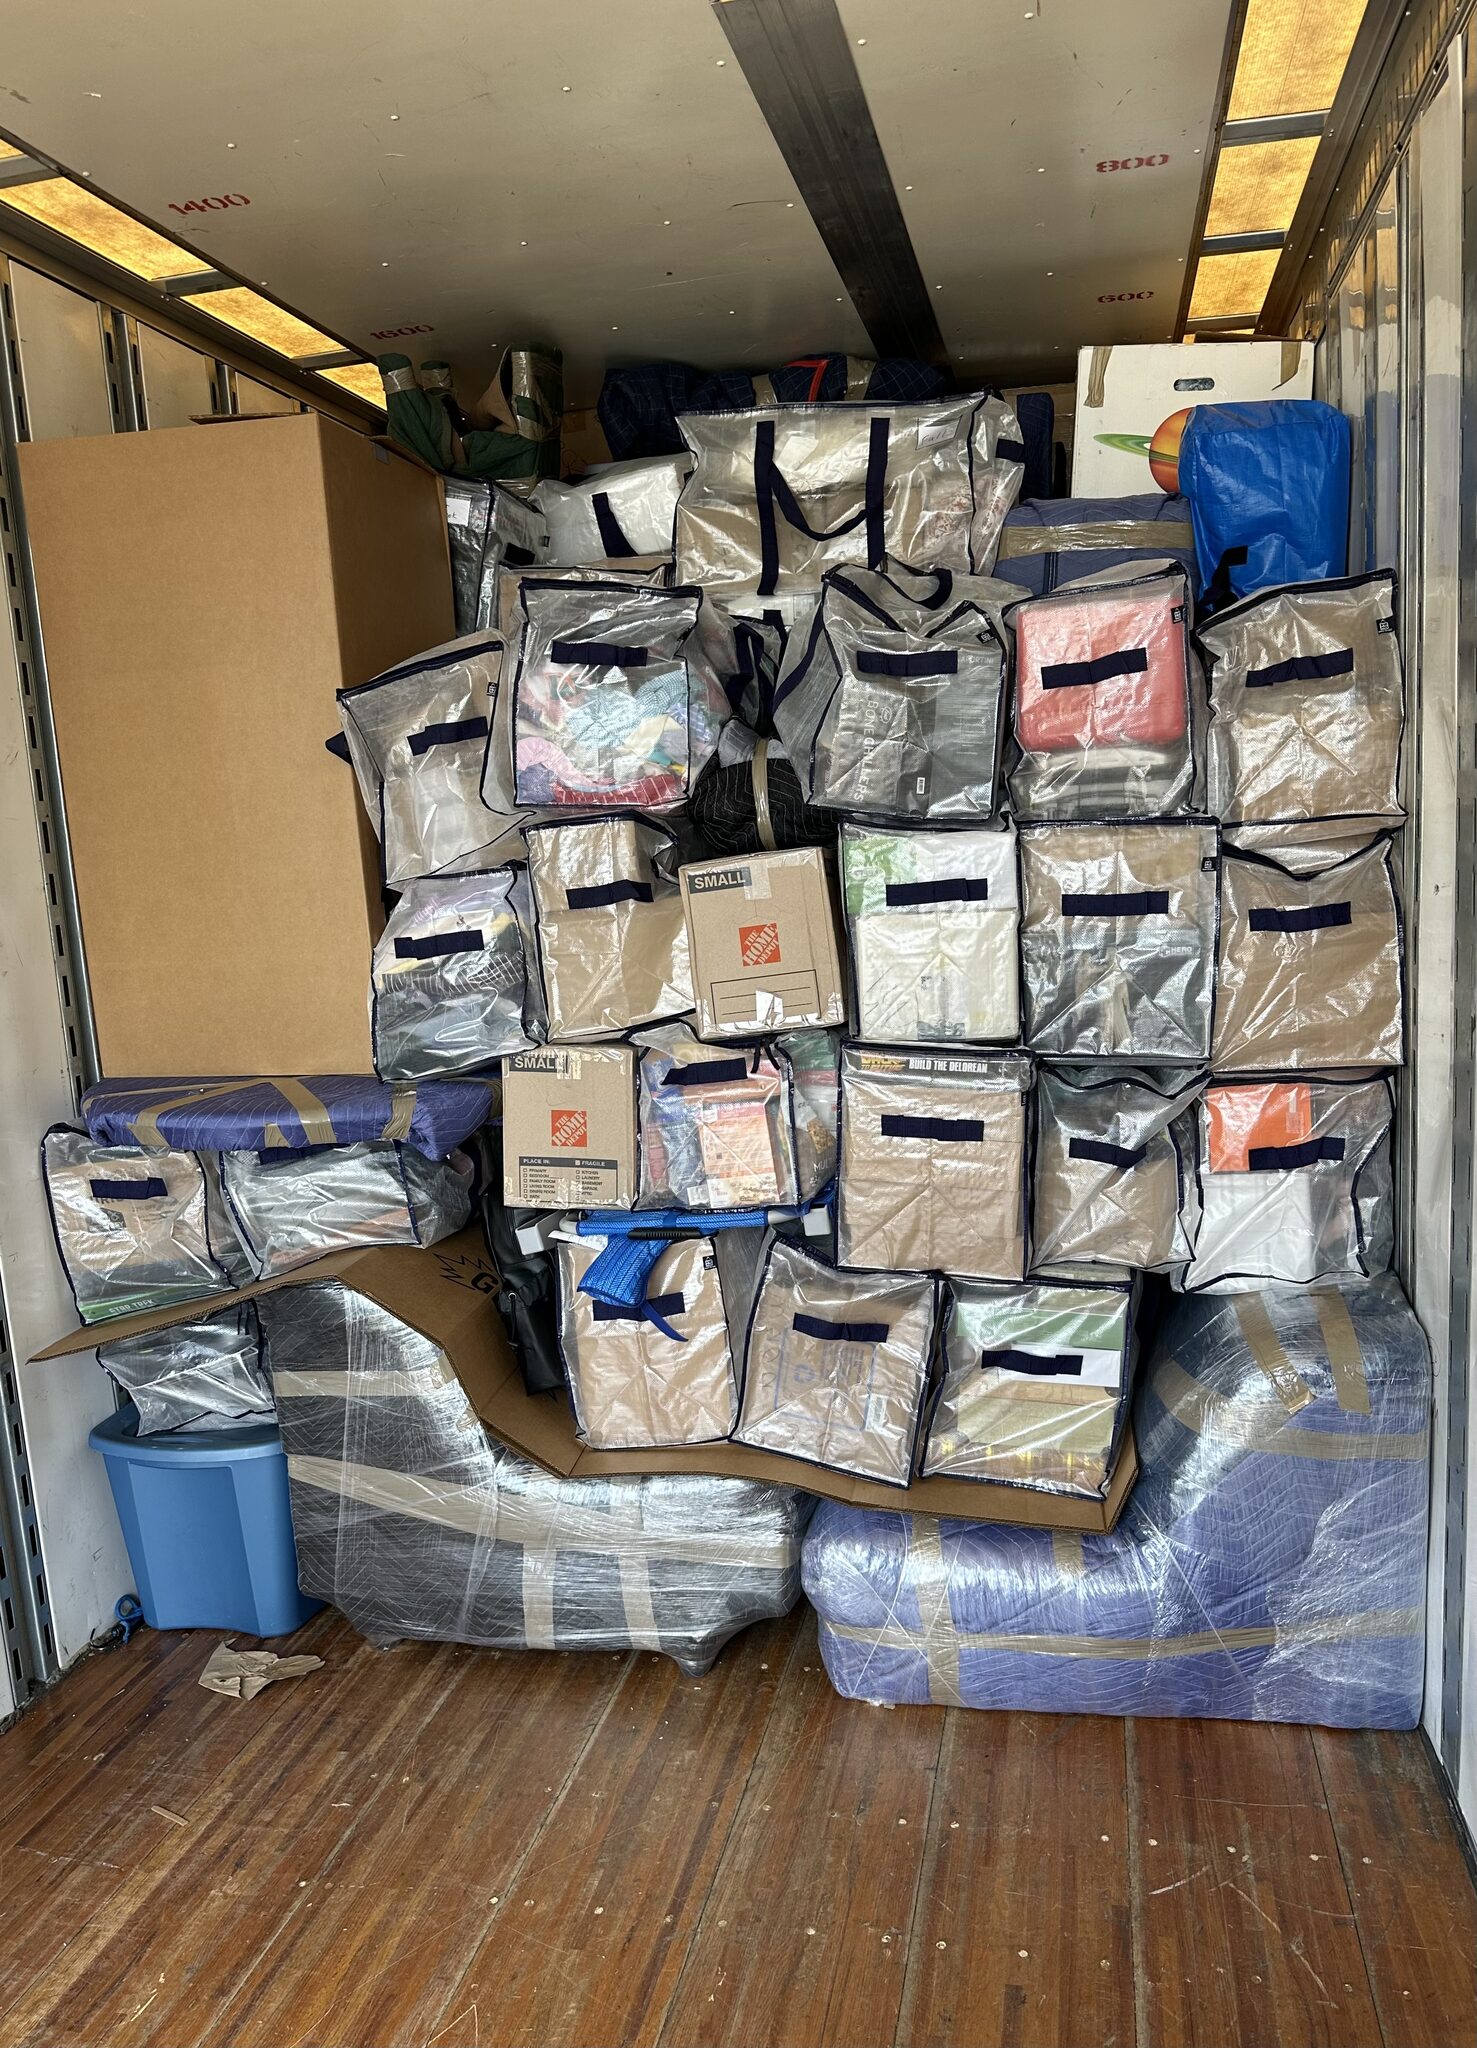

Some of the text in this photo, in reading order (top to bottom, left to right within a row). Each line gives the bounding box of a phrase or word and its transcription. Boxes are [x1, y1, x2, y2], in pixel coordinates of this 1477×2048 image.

[1096, 153, 1169, 173] 800
[168, 193, 251, 215] 1400
[1097, 290, 1154, 303] 600
[370, 324, 434, 340] 1600
[864, 700, 879, 735] BONE
[694, 871, 746, 890] SMALL
[742, 923, 778, 966] HOME
[745, 929, 760, 946] THE
[757, 938, 779, 965] DEPOT
[908, 1057, 988, 1073] BUILD THE DELOREAN
[551, 1110, 587, 1147] HOME
[555, 1114, 570, 1128] THE
[565, 1125, 588, 1147] DEPOT
